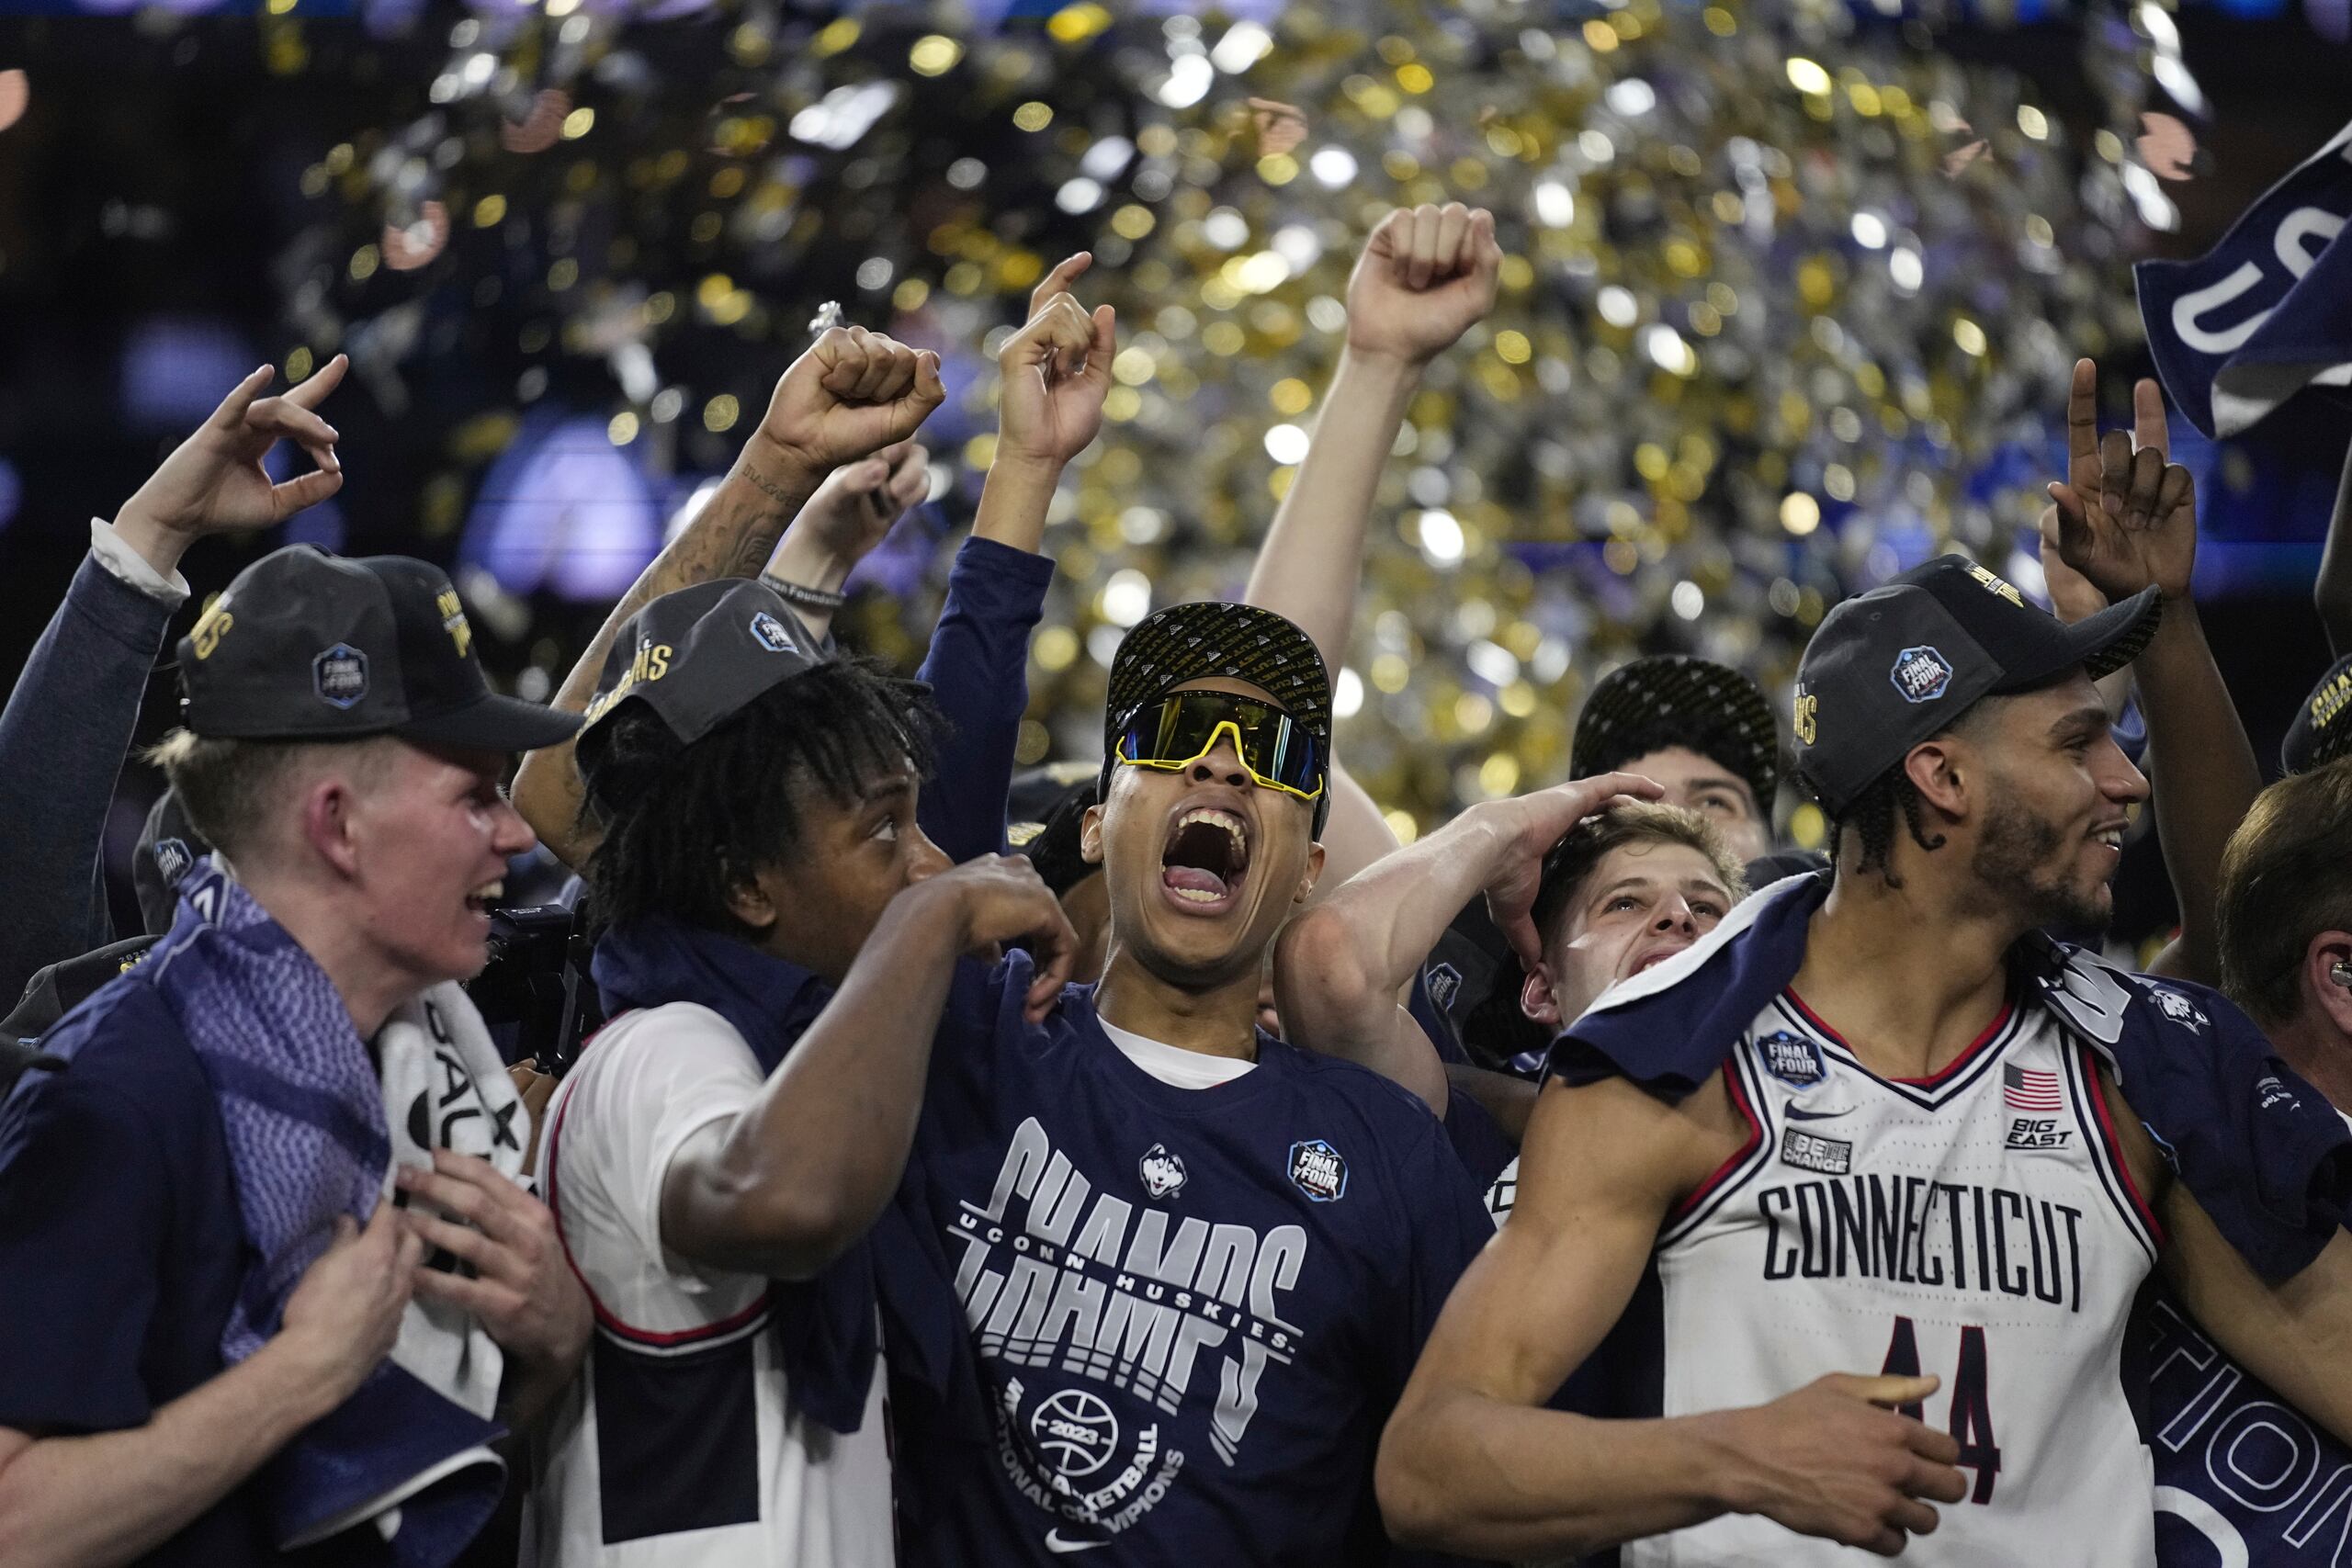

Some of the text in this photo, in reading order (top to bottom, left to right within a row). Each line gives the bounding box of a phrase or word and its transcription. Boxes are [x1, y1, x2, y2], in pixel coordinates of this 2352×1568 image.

[1902, 653, 1934, 684] FINAL
[1911, 661, 1941, 691] FOUR
[1768, 1043, 1812, 1060] FINAL
[1777, 1057, 1818, 1075] FOUR
[2006, 1130, 2074, 1146] EAST
[2011, 1118, 2058, 1134] BIG
[1795, 1134, 1827, 1157] BE
[1299, 1150, 1339, 1177] FINAL
[1782, 1146, 1849, 1174] CHANGE
[1300, 1164, 1340, 1191] FOUR
[958, 1213, 1085, 1271] UCONN
[1758, 1173, 2082, 1314] CONNECTICUT
[1047, 1419, 1100, 1447] 2023
[1036, 1422, 1159, 1513] BAKETBALL
[1060, 1448, 1185, 1535] CHMPIONS
